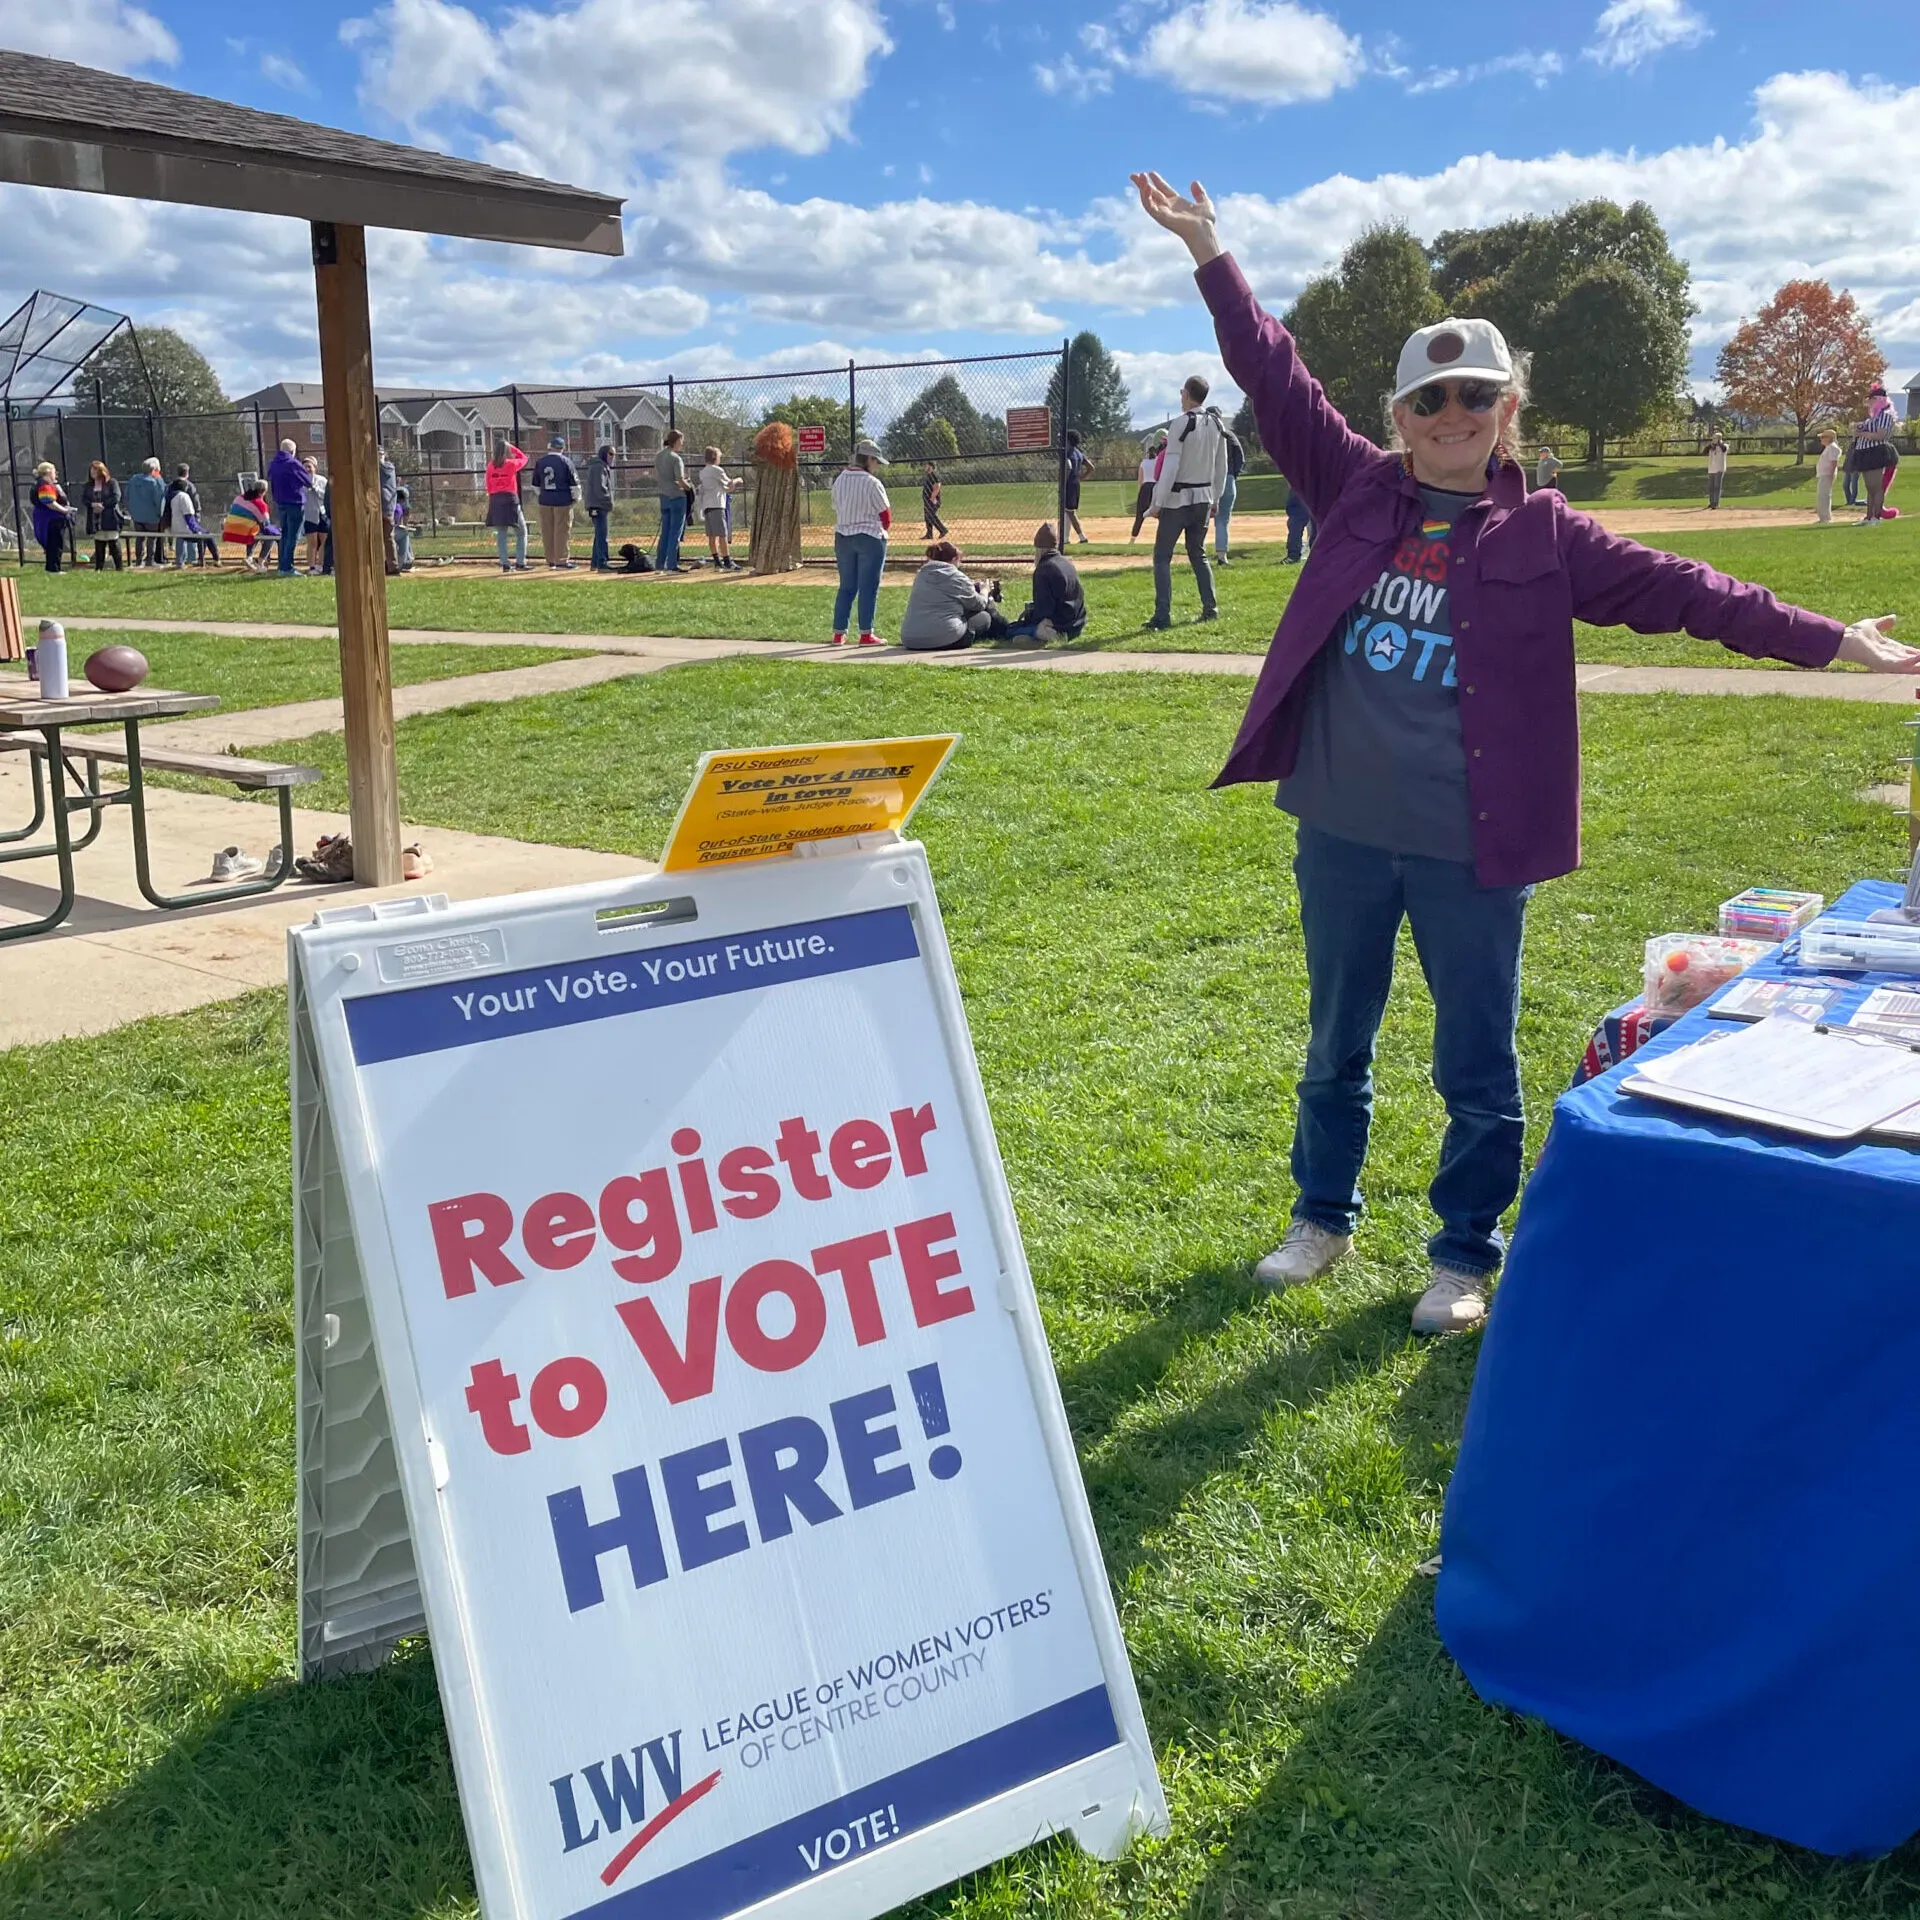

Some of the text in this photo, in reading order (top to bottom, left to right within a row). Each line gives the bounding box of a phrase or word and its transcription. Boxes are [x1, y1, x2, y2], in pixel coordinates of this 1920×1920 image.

[544, 466, 556, 490] 2
[711, 755, 819, 772] PSU Students!
[722, 765, 915, 792] Vote Nov 4 HERE
[765, 786, 853, 803] in town
[698, 821, 878, 850] Out-of-State Students may
[794, 800, 834, 812] Judge
[699, 847, 757, 862] Register
[760, 843, 773, 853] in
[452, 933, 835, 1021] Your Vote. Your Future.
[427, 1102, 937, 1299] Register
[465, 1212, 975, 1455] to VOTE
[546, 1361, 962, 1613] HERE!
[702, 1687, 812, 1752] LEAGUE
[815, 1678, 845, 1705] OF
[848, 1631, 953, 1690] WOMEN
[740, 1647, 986, 1768] OF CENTRE COUNTY
[549, 1729, 683, 1854] LWV
[798, 1804, 899, 1872] VOTE!
